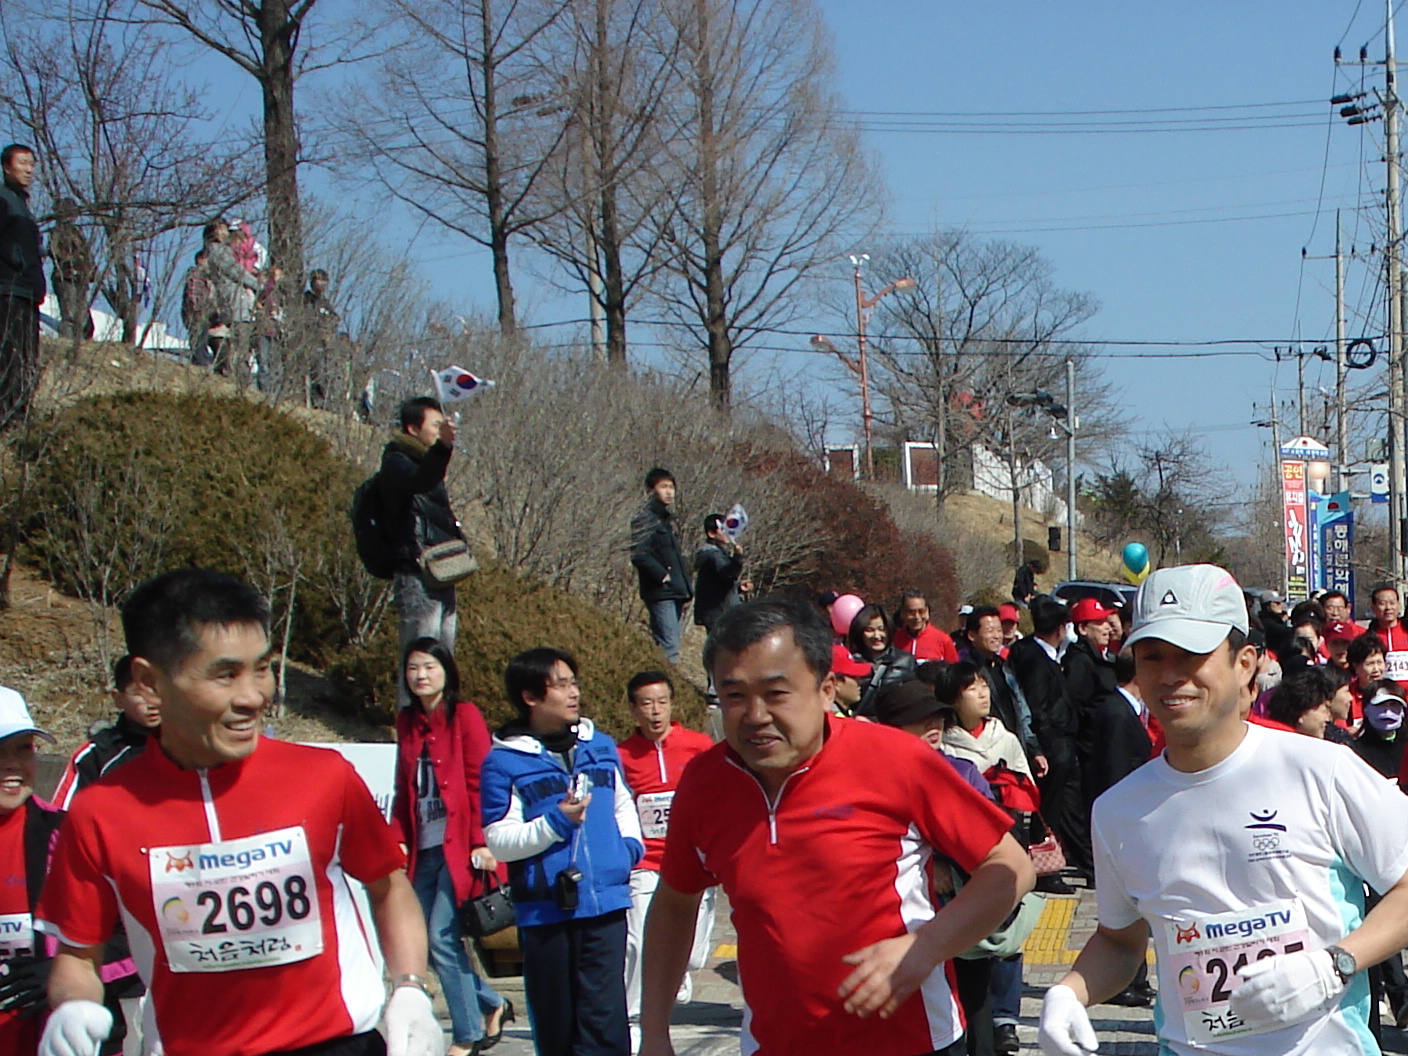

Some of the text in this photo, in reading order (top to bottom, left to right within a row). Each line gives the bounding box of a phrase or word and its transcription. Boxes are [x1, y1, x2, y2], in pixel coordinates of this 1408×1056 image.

[1386, 661, 1408, 672] 2143
[199, 839, 293, 870] megaTV
[197, 875, 311, 935] 2698
[0, 922, 22, 933] TV
[1205, 909, 1291, 939] megaTV
[189, 937, 292, 962] 처음처럼
